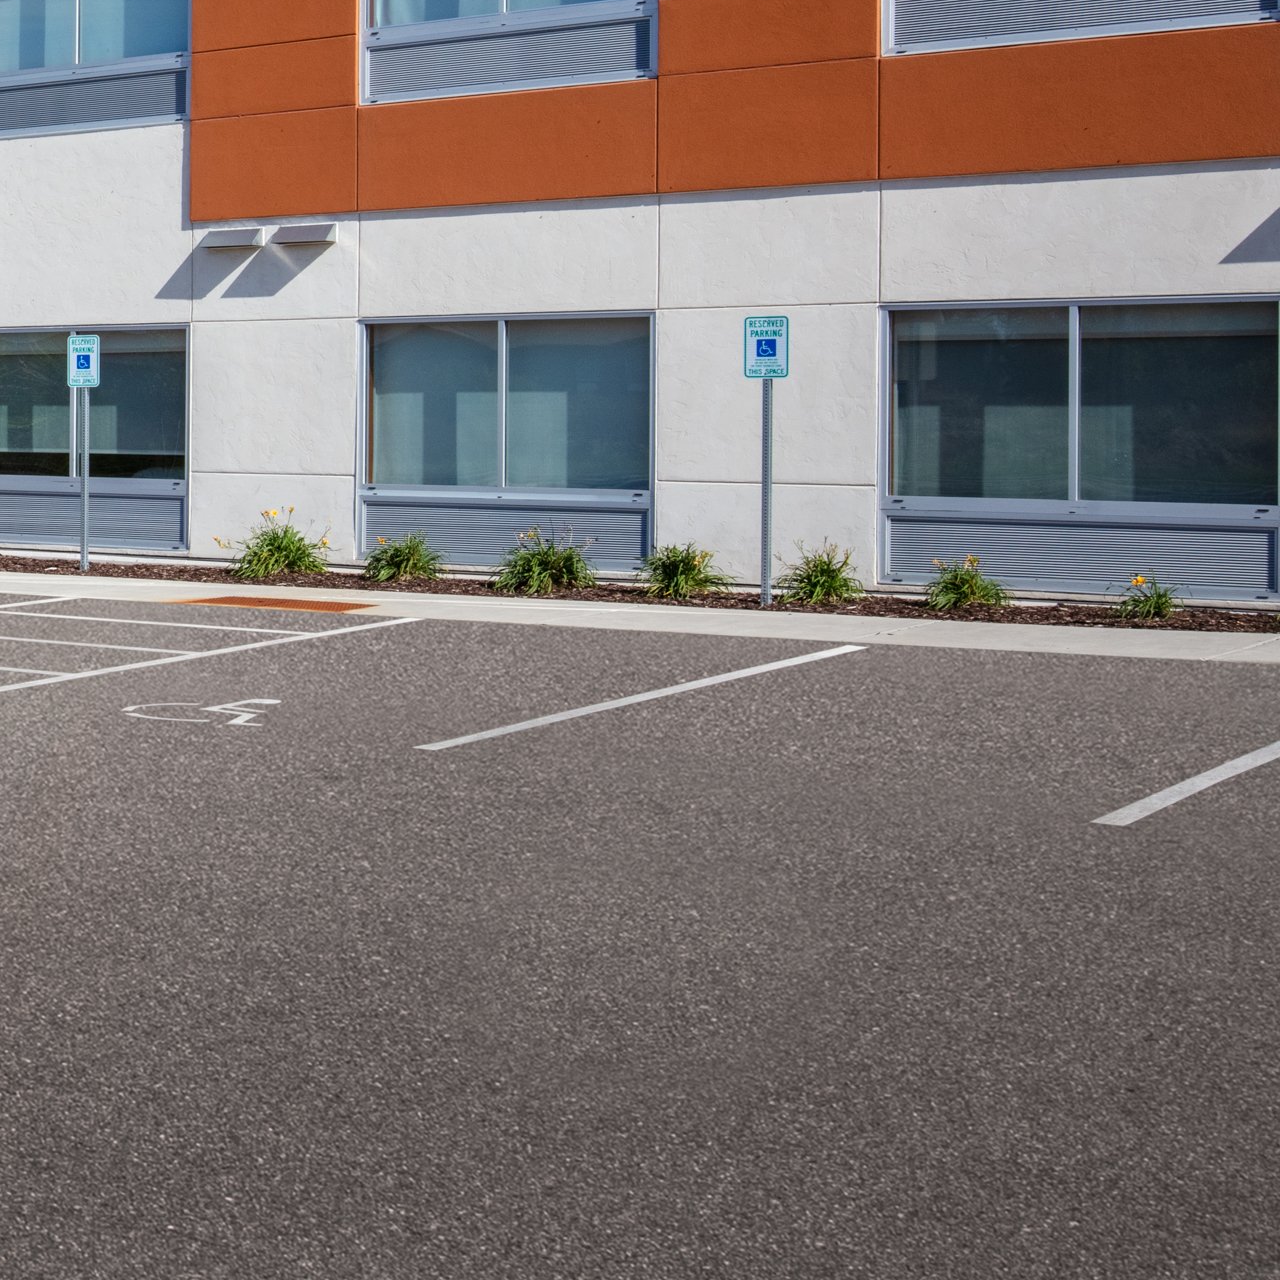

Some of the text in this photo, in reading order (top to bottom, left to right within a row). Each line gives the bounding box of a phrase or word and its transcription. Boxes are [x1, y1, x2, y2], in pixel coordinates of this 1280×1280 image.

[748, 319, 784, 328] RESERVED
[750, 329, 783, 338] PARKING
[71, 338, 95, 346] RESERVED
